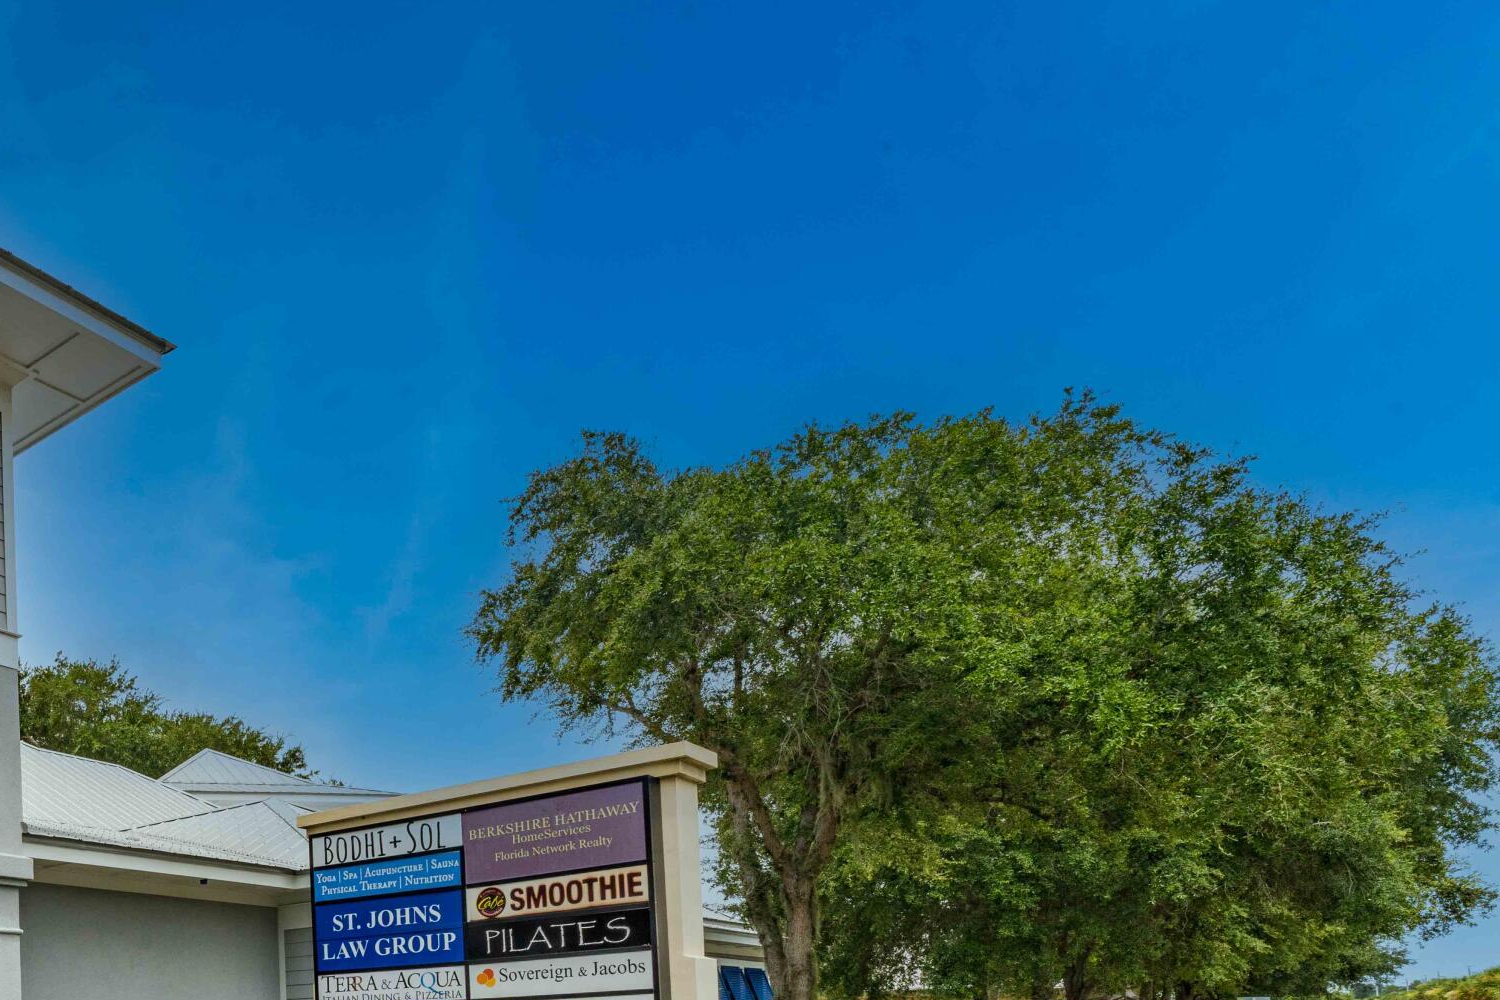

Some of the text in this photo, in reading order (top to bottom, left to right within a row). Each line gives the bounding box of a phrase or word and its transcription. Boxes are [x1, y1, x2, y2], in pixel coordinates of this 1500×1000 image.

[469, 801, 640, 841] BERKSHIRE HATHAWAY
[512, 825, 592, 844] HomeServices
[324, 830, 386, 865] BODHI
[406, 820, 446, 854] SOL
[495, 835, 613, 862] Florida Network Realty
[510, 872, 643, 911] SMOOTHIE
[332, 904, 442, 932] ST. JOHNS
[322, 932, 456, 961] LAW GROUP
[485, 917, 631, 954] PILATES
[321, 971, 463, 994] TERRA & ACQUA
[499, 959, 646, 983] Sovereign & Jacobs
[404, 992, 411, 1000] &
[416, 990, 463, 1000] PIZZERIA
